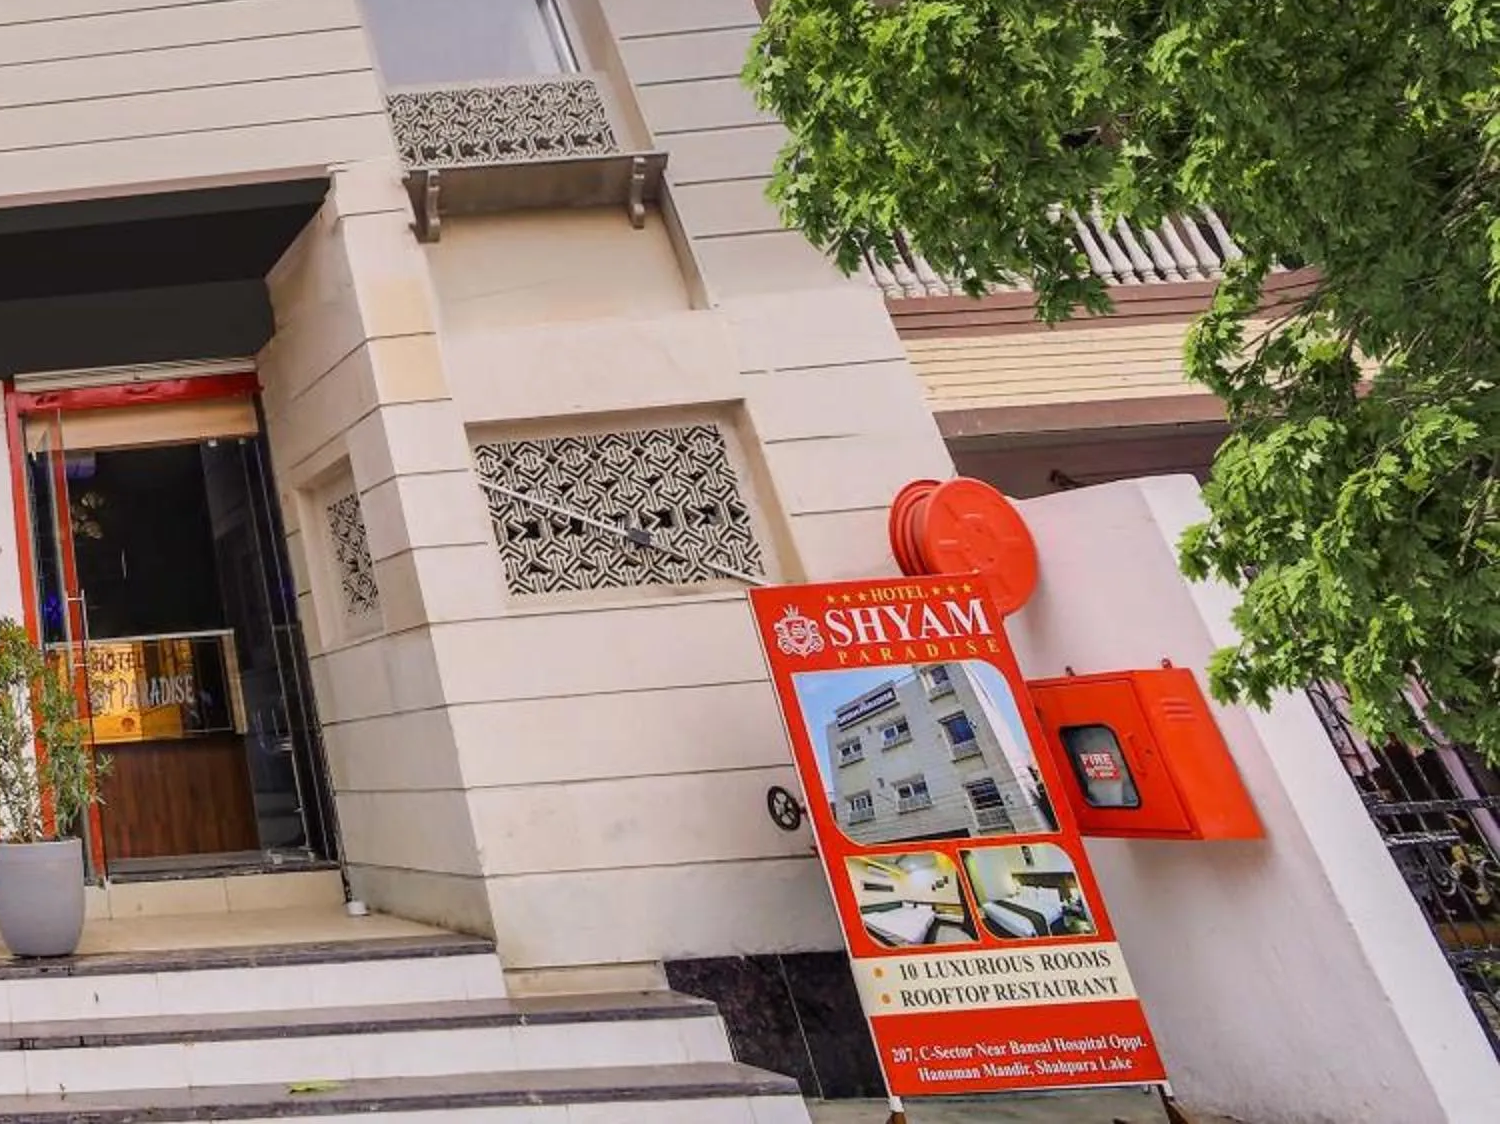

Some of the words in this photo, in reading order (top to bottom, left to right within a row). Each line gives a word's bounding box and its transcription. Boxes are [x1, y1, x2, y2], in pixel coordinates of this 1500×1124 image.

[871, 585, 929, 603] HOTEL
[824, 598, 995, 648] SHYAM
[837, 638, 1001, 665] PARADISE
[899, 962, 918, 982] 10
[923, 955, 1036, 980] LUXURIOUS
[1041, 949, 1113, 972] ROOMS
[900, 985, 990, 1009] ROOFTOP
[992, 976, 1119, 1003] RESTAURANT
[919, 1044, 974, 1062] C-Sector
[975, 1041, 1007, 1057] Near
[1009, 1038, 1053, 1055] Bansal
[1053, 1035, 1108, 1055] Hospital
[917, 1066, 981, 1083] Hanuman
[1099, 1055, 1133, 1072] Lake
